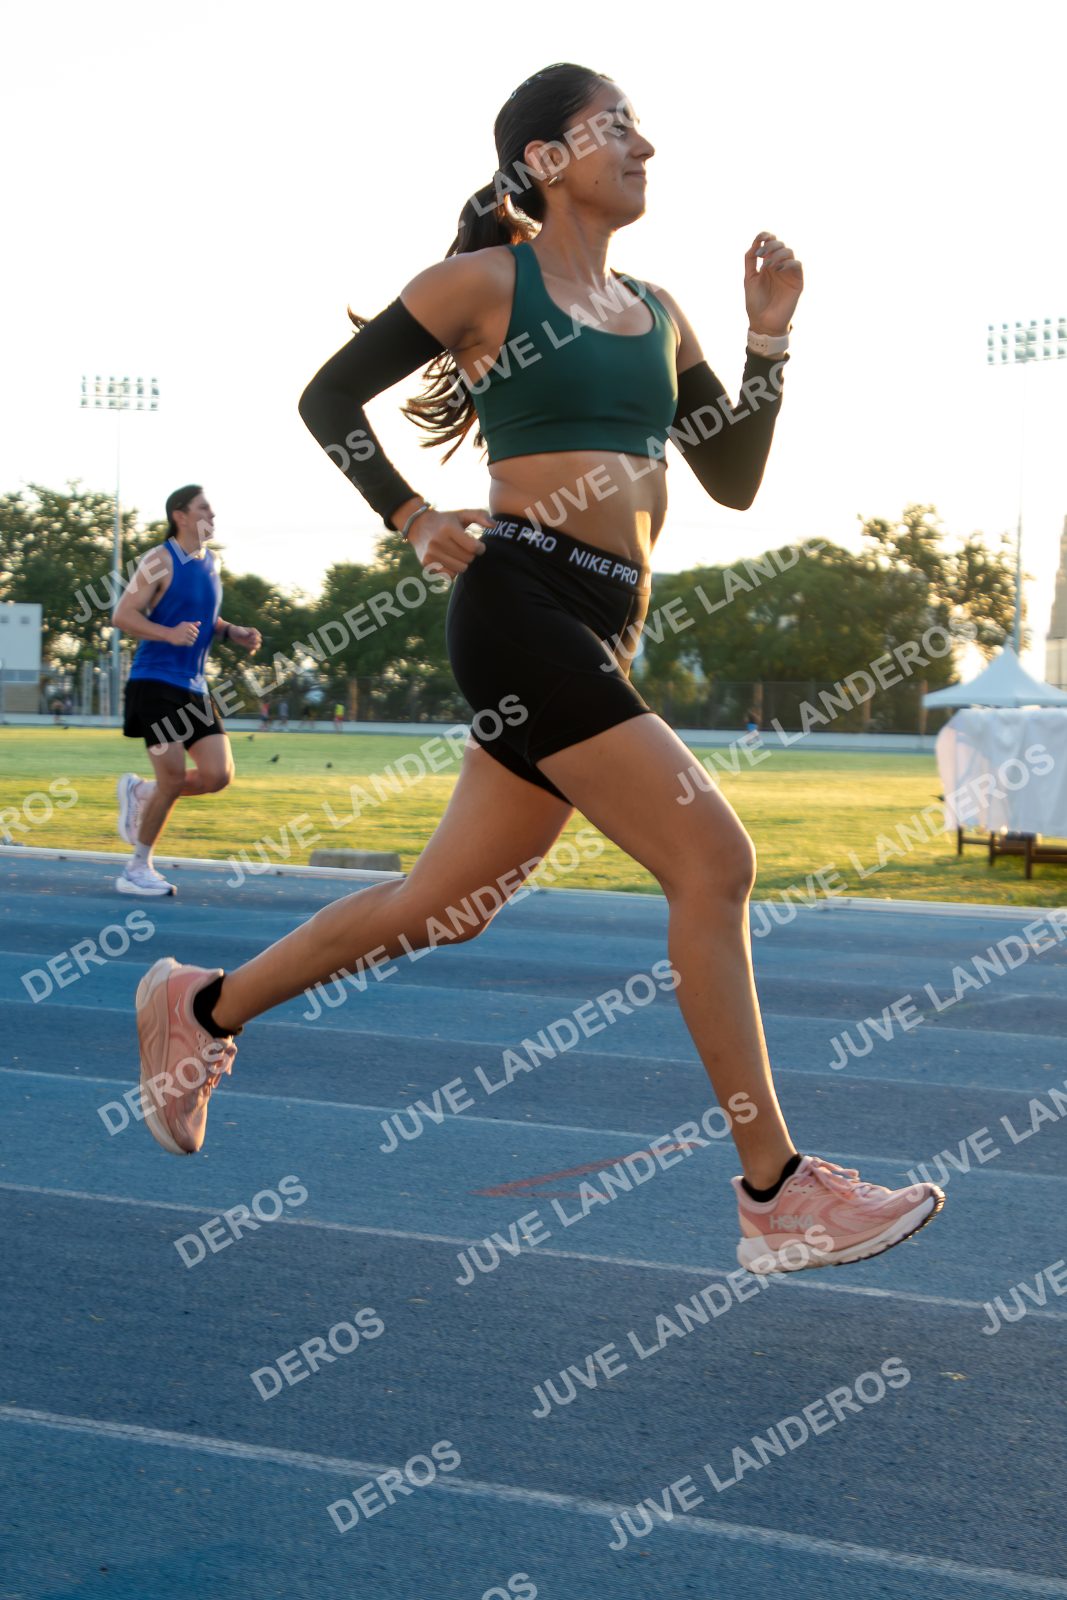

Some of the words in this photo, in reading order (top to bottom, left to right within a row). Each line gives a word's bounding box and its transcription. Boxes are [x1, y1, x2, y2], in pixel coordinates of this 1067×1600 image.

[516, 526, 557, 552] PRO
[569, 547, 612, 575] NIKE
[611, 563, 638, 584] PRO
[769, 1214, 815, 1231] HOKA
